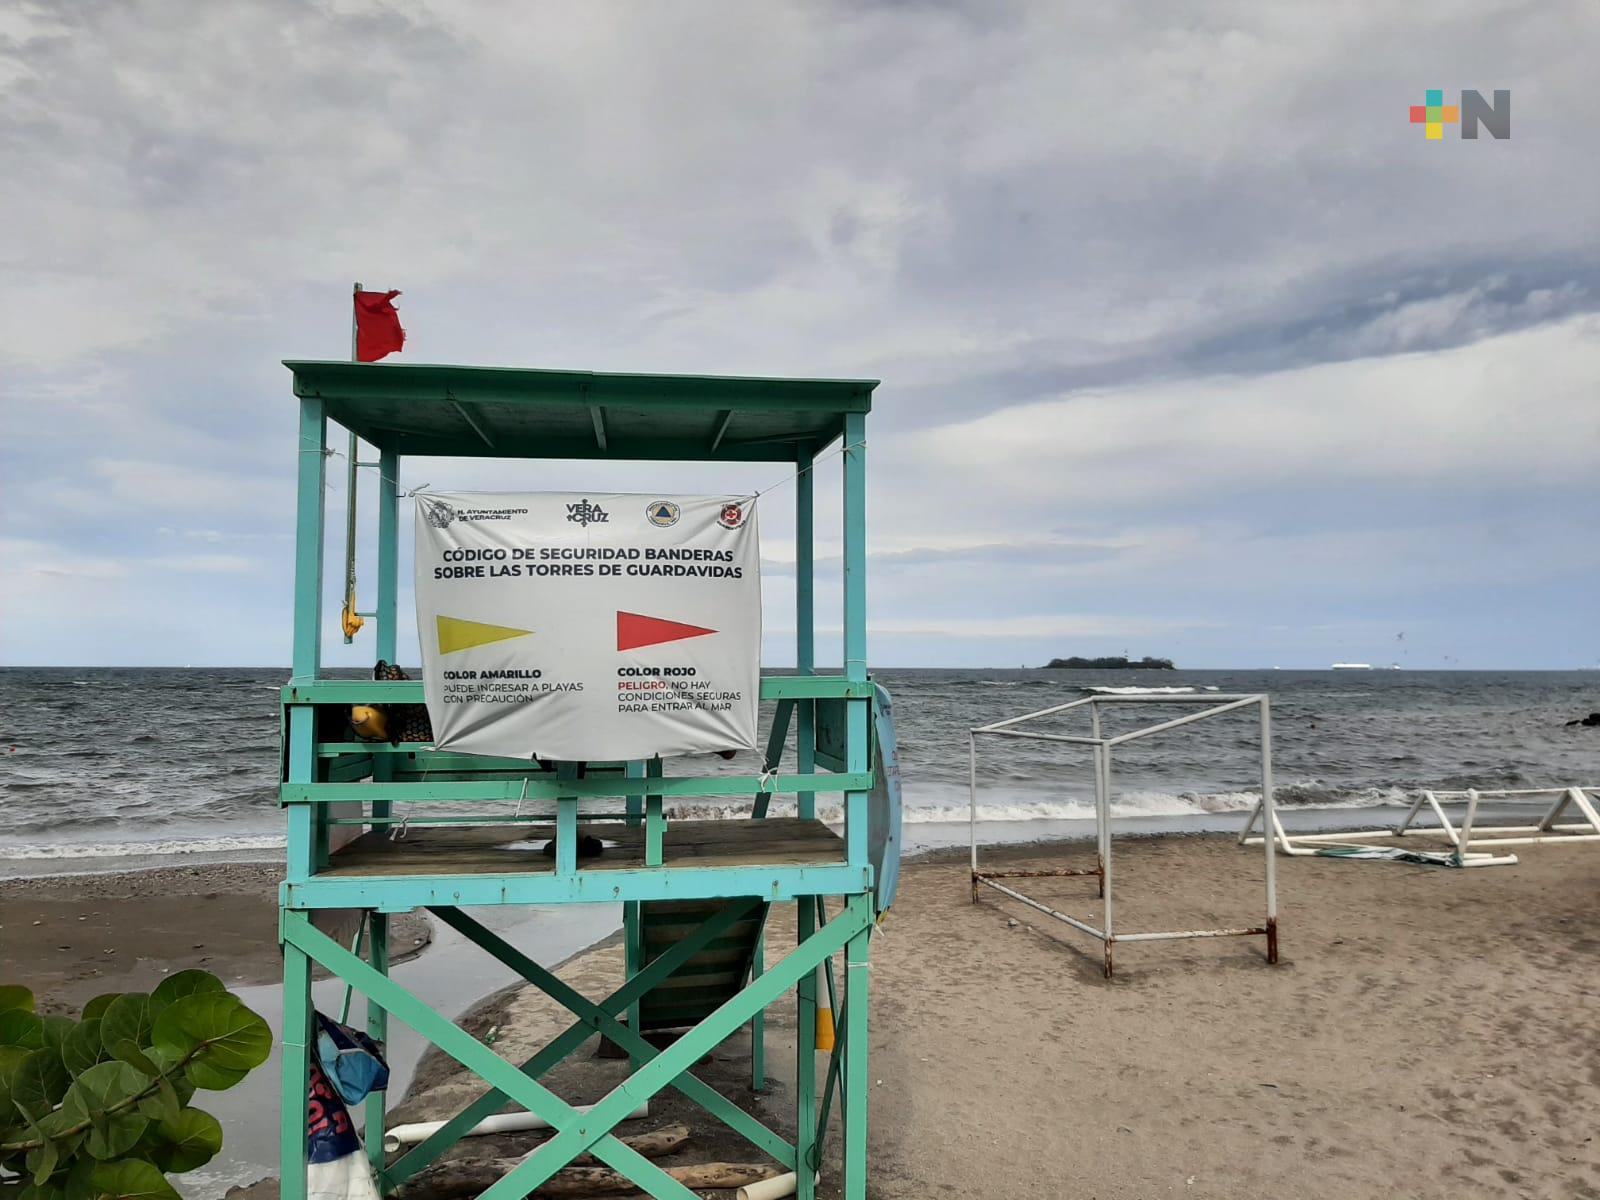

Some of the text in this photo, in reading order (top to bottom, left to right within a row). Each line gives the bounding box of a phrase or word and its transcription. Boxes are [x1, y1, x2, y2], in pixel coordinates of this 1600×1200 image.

[443, 547, 733, 562] CÓDIGO DE SEGURIDAD BANDERAS
[434, 564, 742, 580] SOBRE LAS TORRES DE GUARDAVIDAS
[443, 669, 542, 680] COLOR AMARILLO
[617, 667, 696, 676] COLOR ROJO
[477, 683, 529, 693] INGRESAR
[531, 683, 539, 691] A
[542, 682, 584, 692] PLAYAS
[671, 681, 689, 690] NO
[691, 681, 711, 690] HAY
[443, 693, 534, 704] CON PRECAUCIÓN
[618, 692, 741, 702] CONDICIONES SEGURAS
[618, 702, 732, 713] PARA ENTRAR AL MAR
